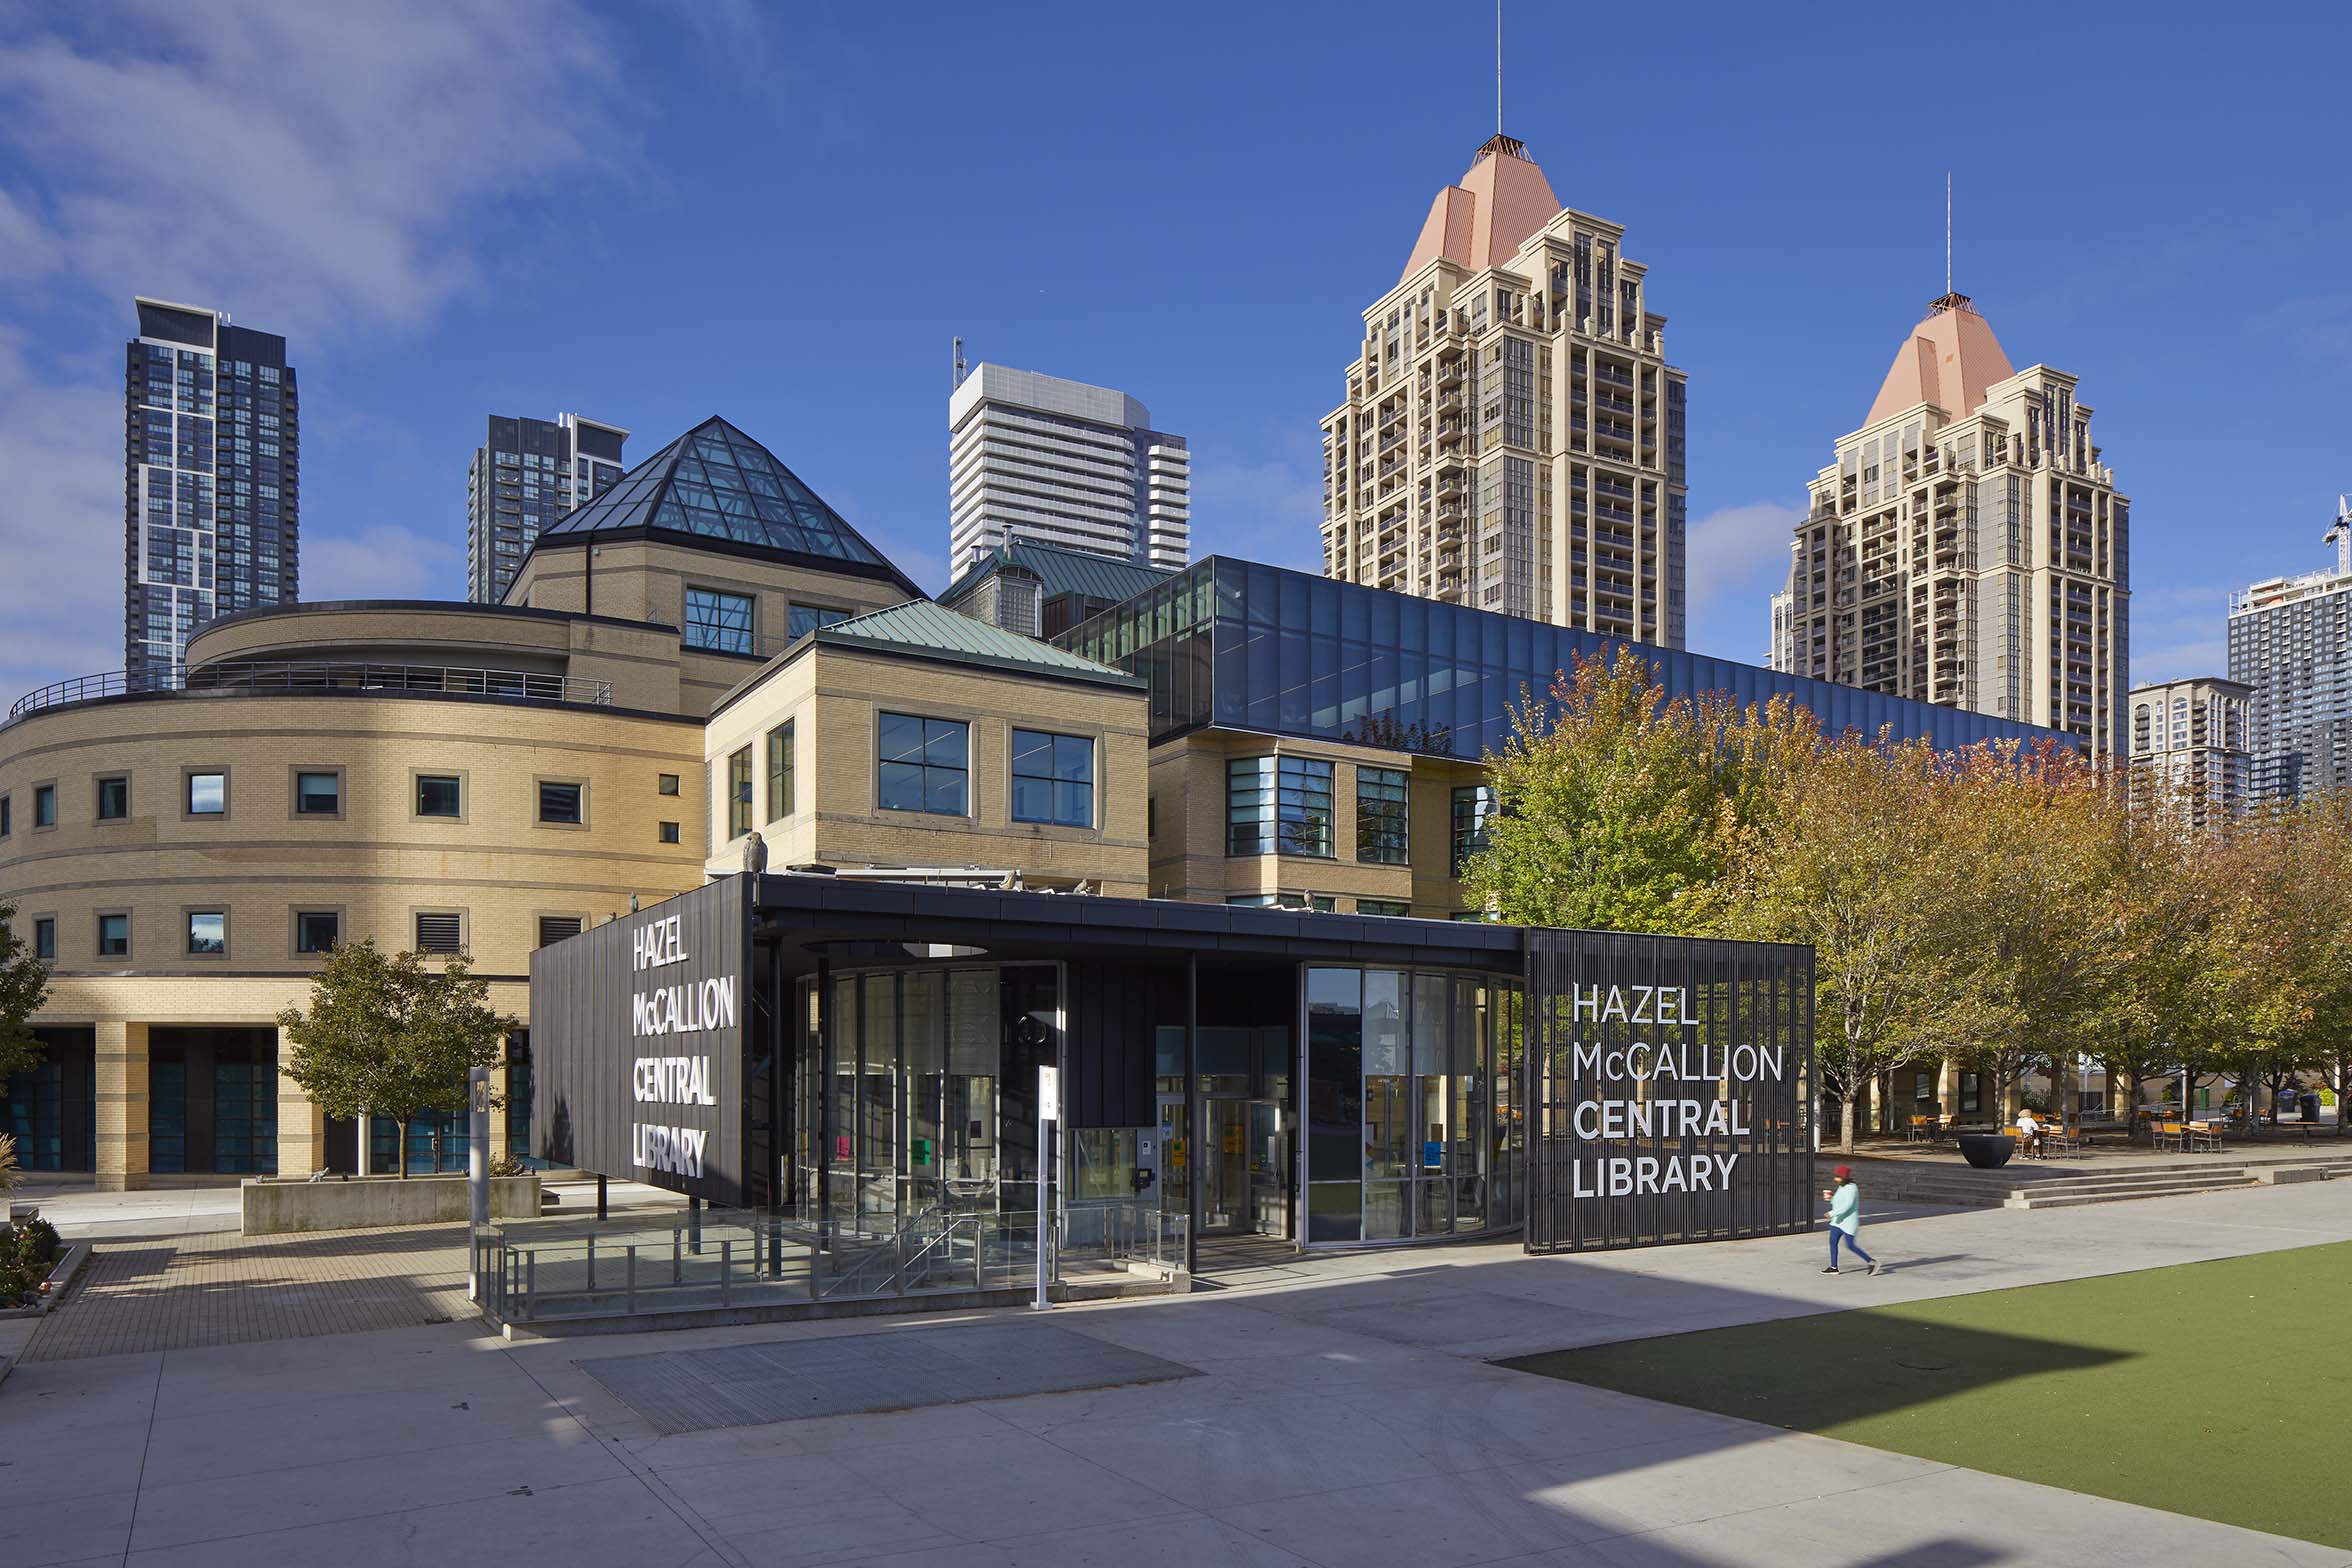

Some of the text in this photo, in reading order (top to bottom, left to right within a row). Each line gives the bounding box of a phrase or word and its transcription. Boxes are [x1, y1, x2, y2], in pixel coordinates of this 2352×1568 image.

[634, 914, 688, 971] HAZEL
[634, 975, 736, 1036] McCALLION
[1574, 983, 1699, 1025] HAZEL
[633, 1055, 716, 1106] CENTRAL
[1574, 1041, 1782, 1082] McCALLION
[1574, 1099, 1750, 1140] CENTRAL
[633, 1122, 709, 1178] LIBRARY
[1573, 1153, 1738, 1198] LIBRARY
